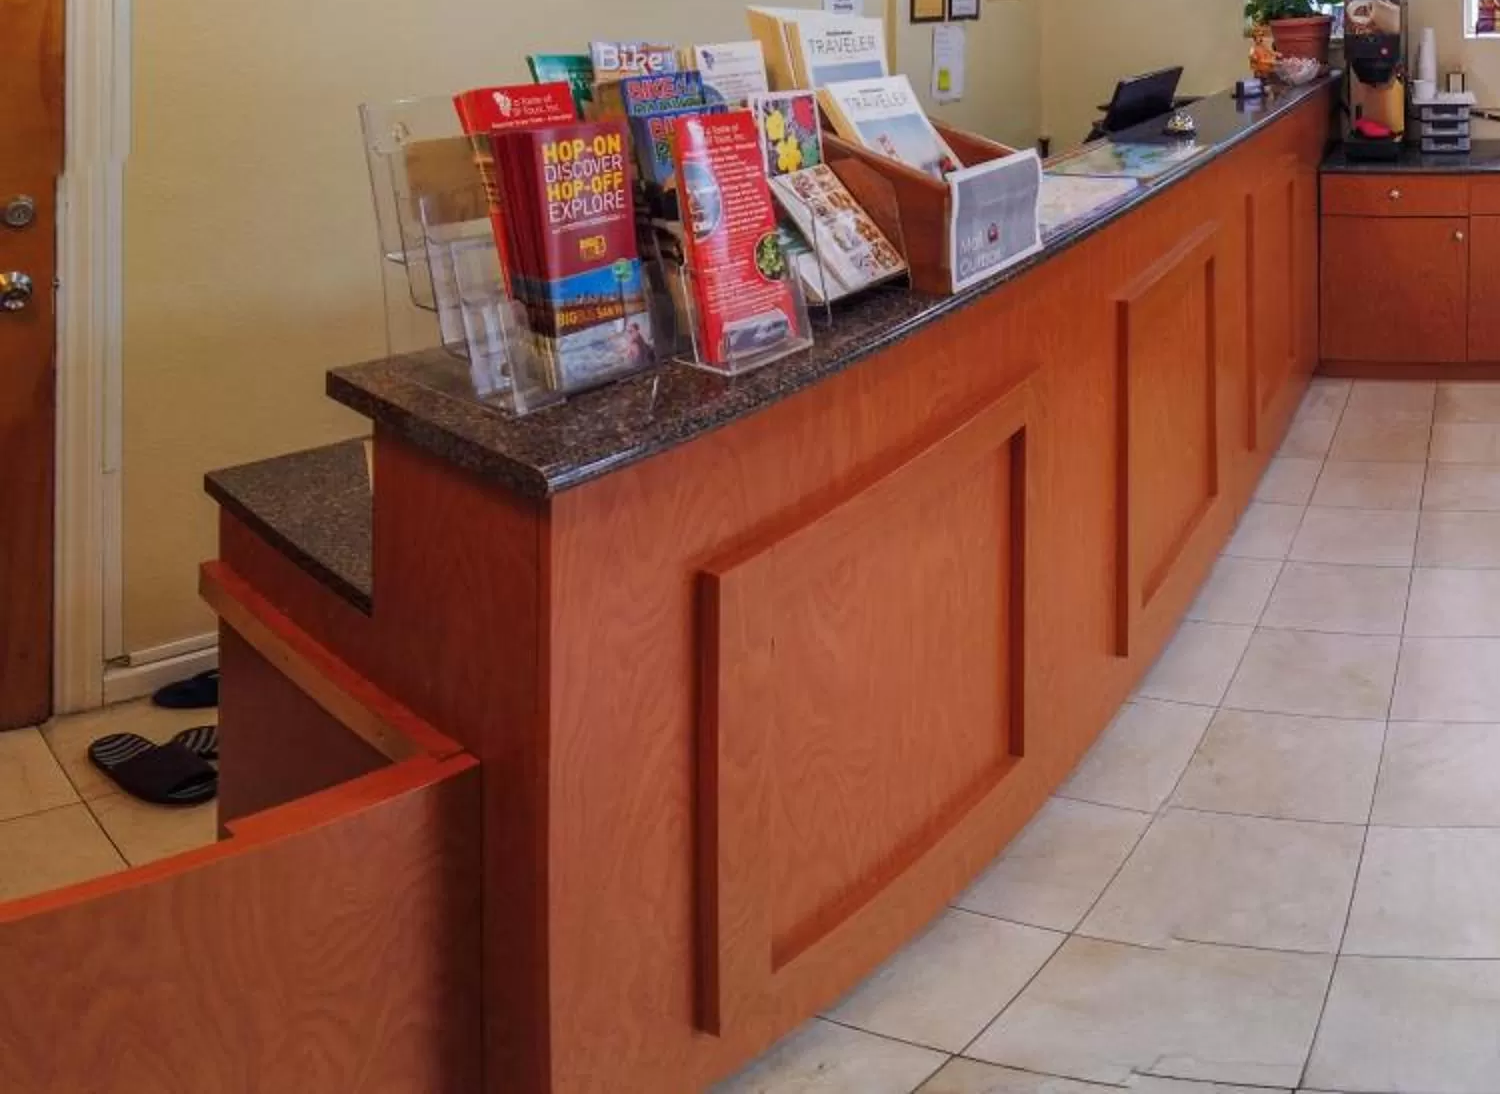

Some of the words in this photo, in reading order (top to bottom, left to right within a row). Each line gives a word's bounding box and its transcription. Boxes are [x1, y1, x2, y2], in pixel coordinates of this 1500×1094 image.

[600, 45, 663, 75] Bike
[808, 35, 876, 55] TRAVELER
[844, 91, 908, 108] TRAVELER
[542, 133, 621, 164] HOP-ON
[544, 154, 623, 182] DISCOVER
[547, 172, 624, 202] HOP-OFF
[549, 190, 625, 223] EXPLORE
